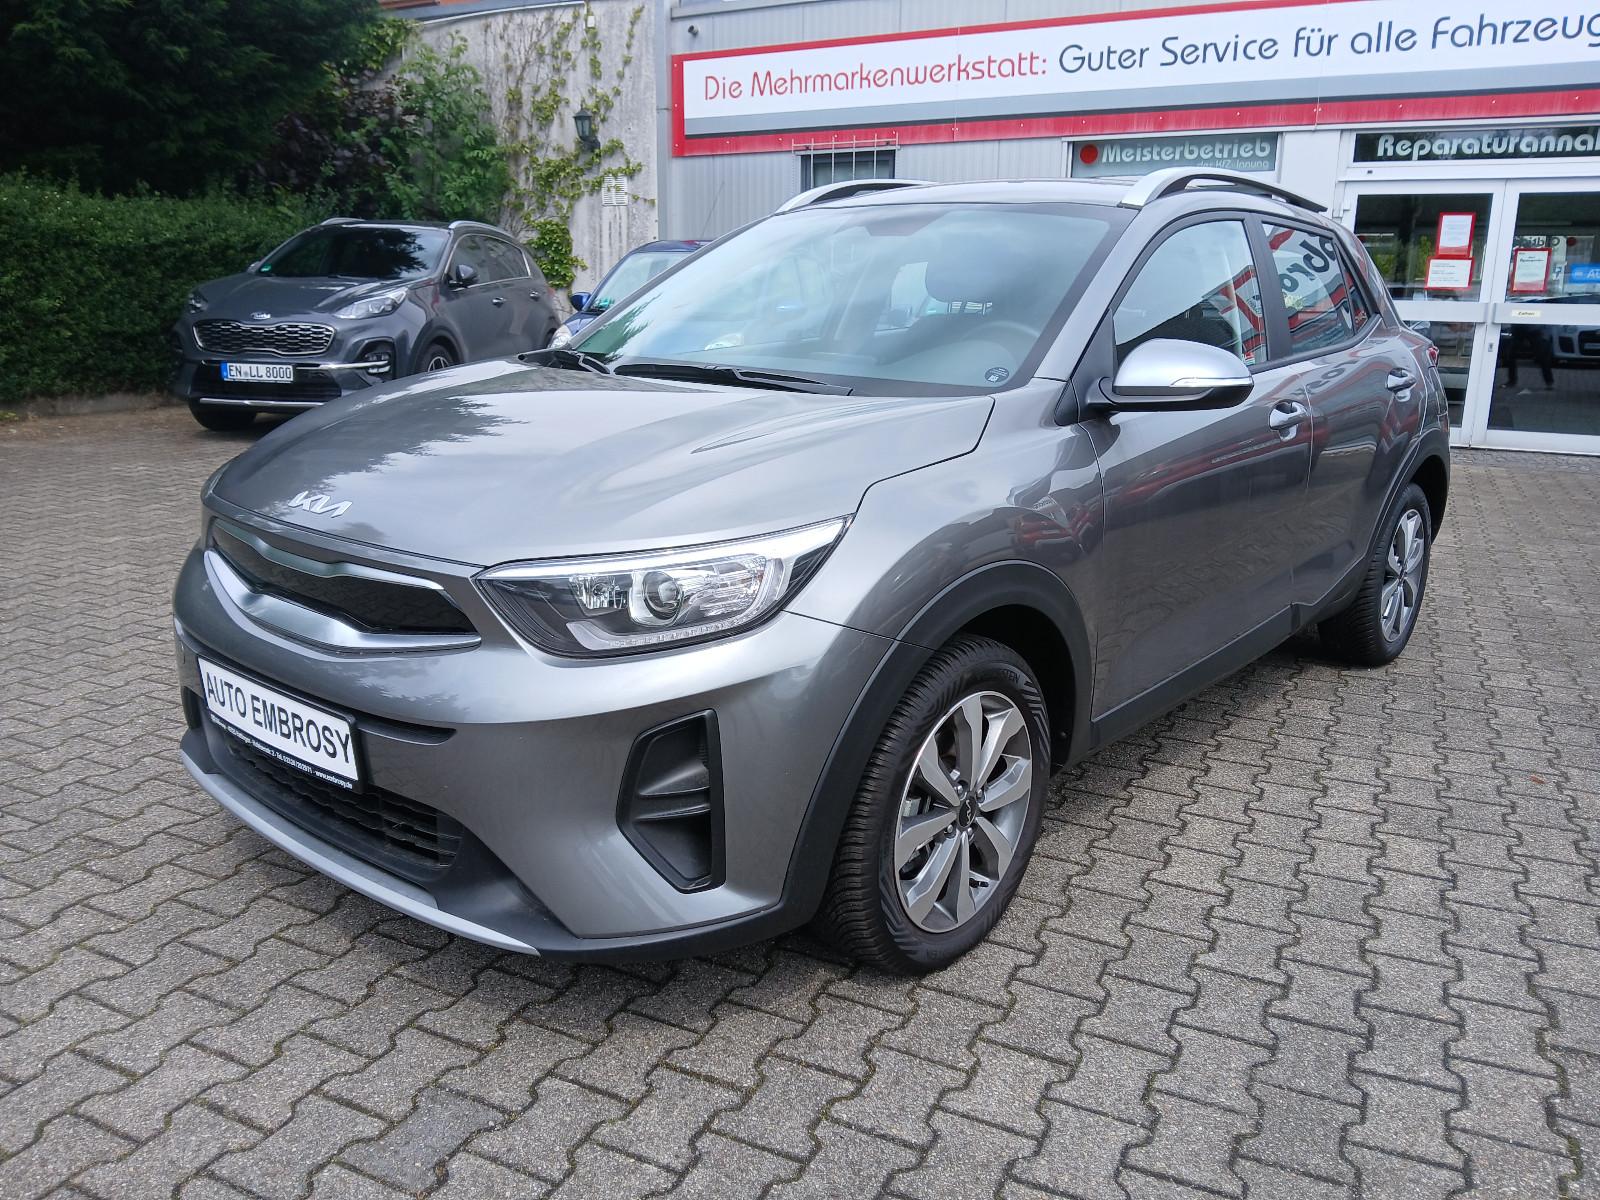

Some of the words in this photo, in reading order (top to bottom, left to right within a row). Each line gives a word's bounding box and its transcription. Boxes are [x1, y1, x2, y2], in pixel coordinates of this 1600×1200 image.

[704, 74, 743, 101] Die
[751, 51, 1048, 97] Mehrmarkenwerkstatt:
[1058, 43, 1150, 74] Guter
[1159, 34, 1279, 67] Service
[1293, 26, 1339, 58] für
[1350, 20, 1418, 55] alle
[1101, 138, 1271, 164] Meisterbetrieb
[1376, 127, 1600, 161] Reparaturanna
[228, 364, 242, 378] EN
[249, 365, 263, 378] LL
[265, 366, 292, 379] 8000
[205, 671, 247, 719] AUTO
[250, 693, 350, 764] EMBROSY
